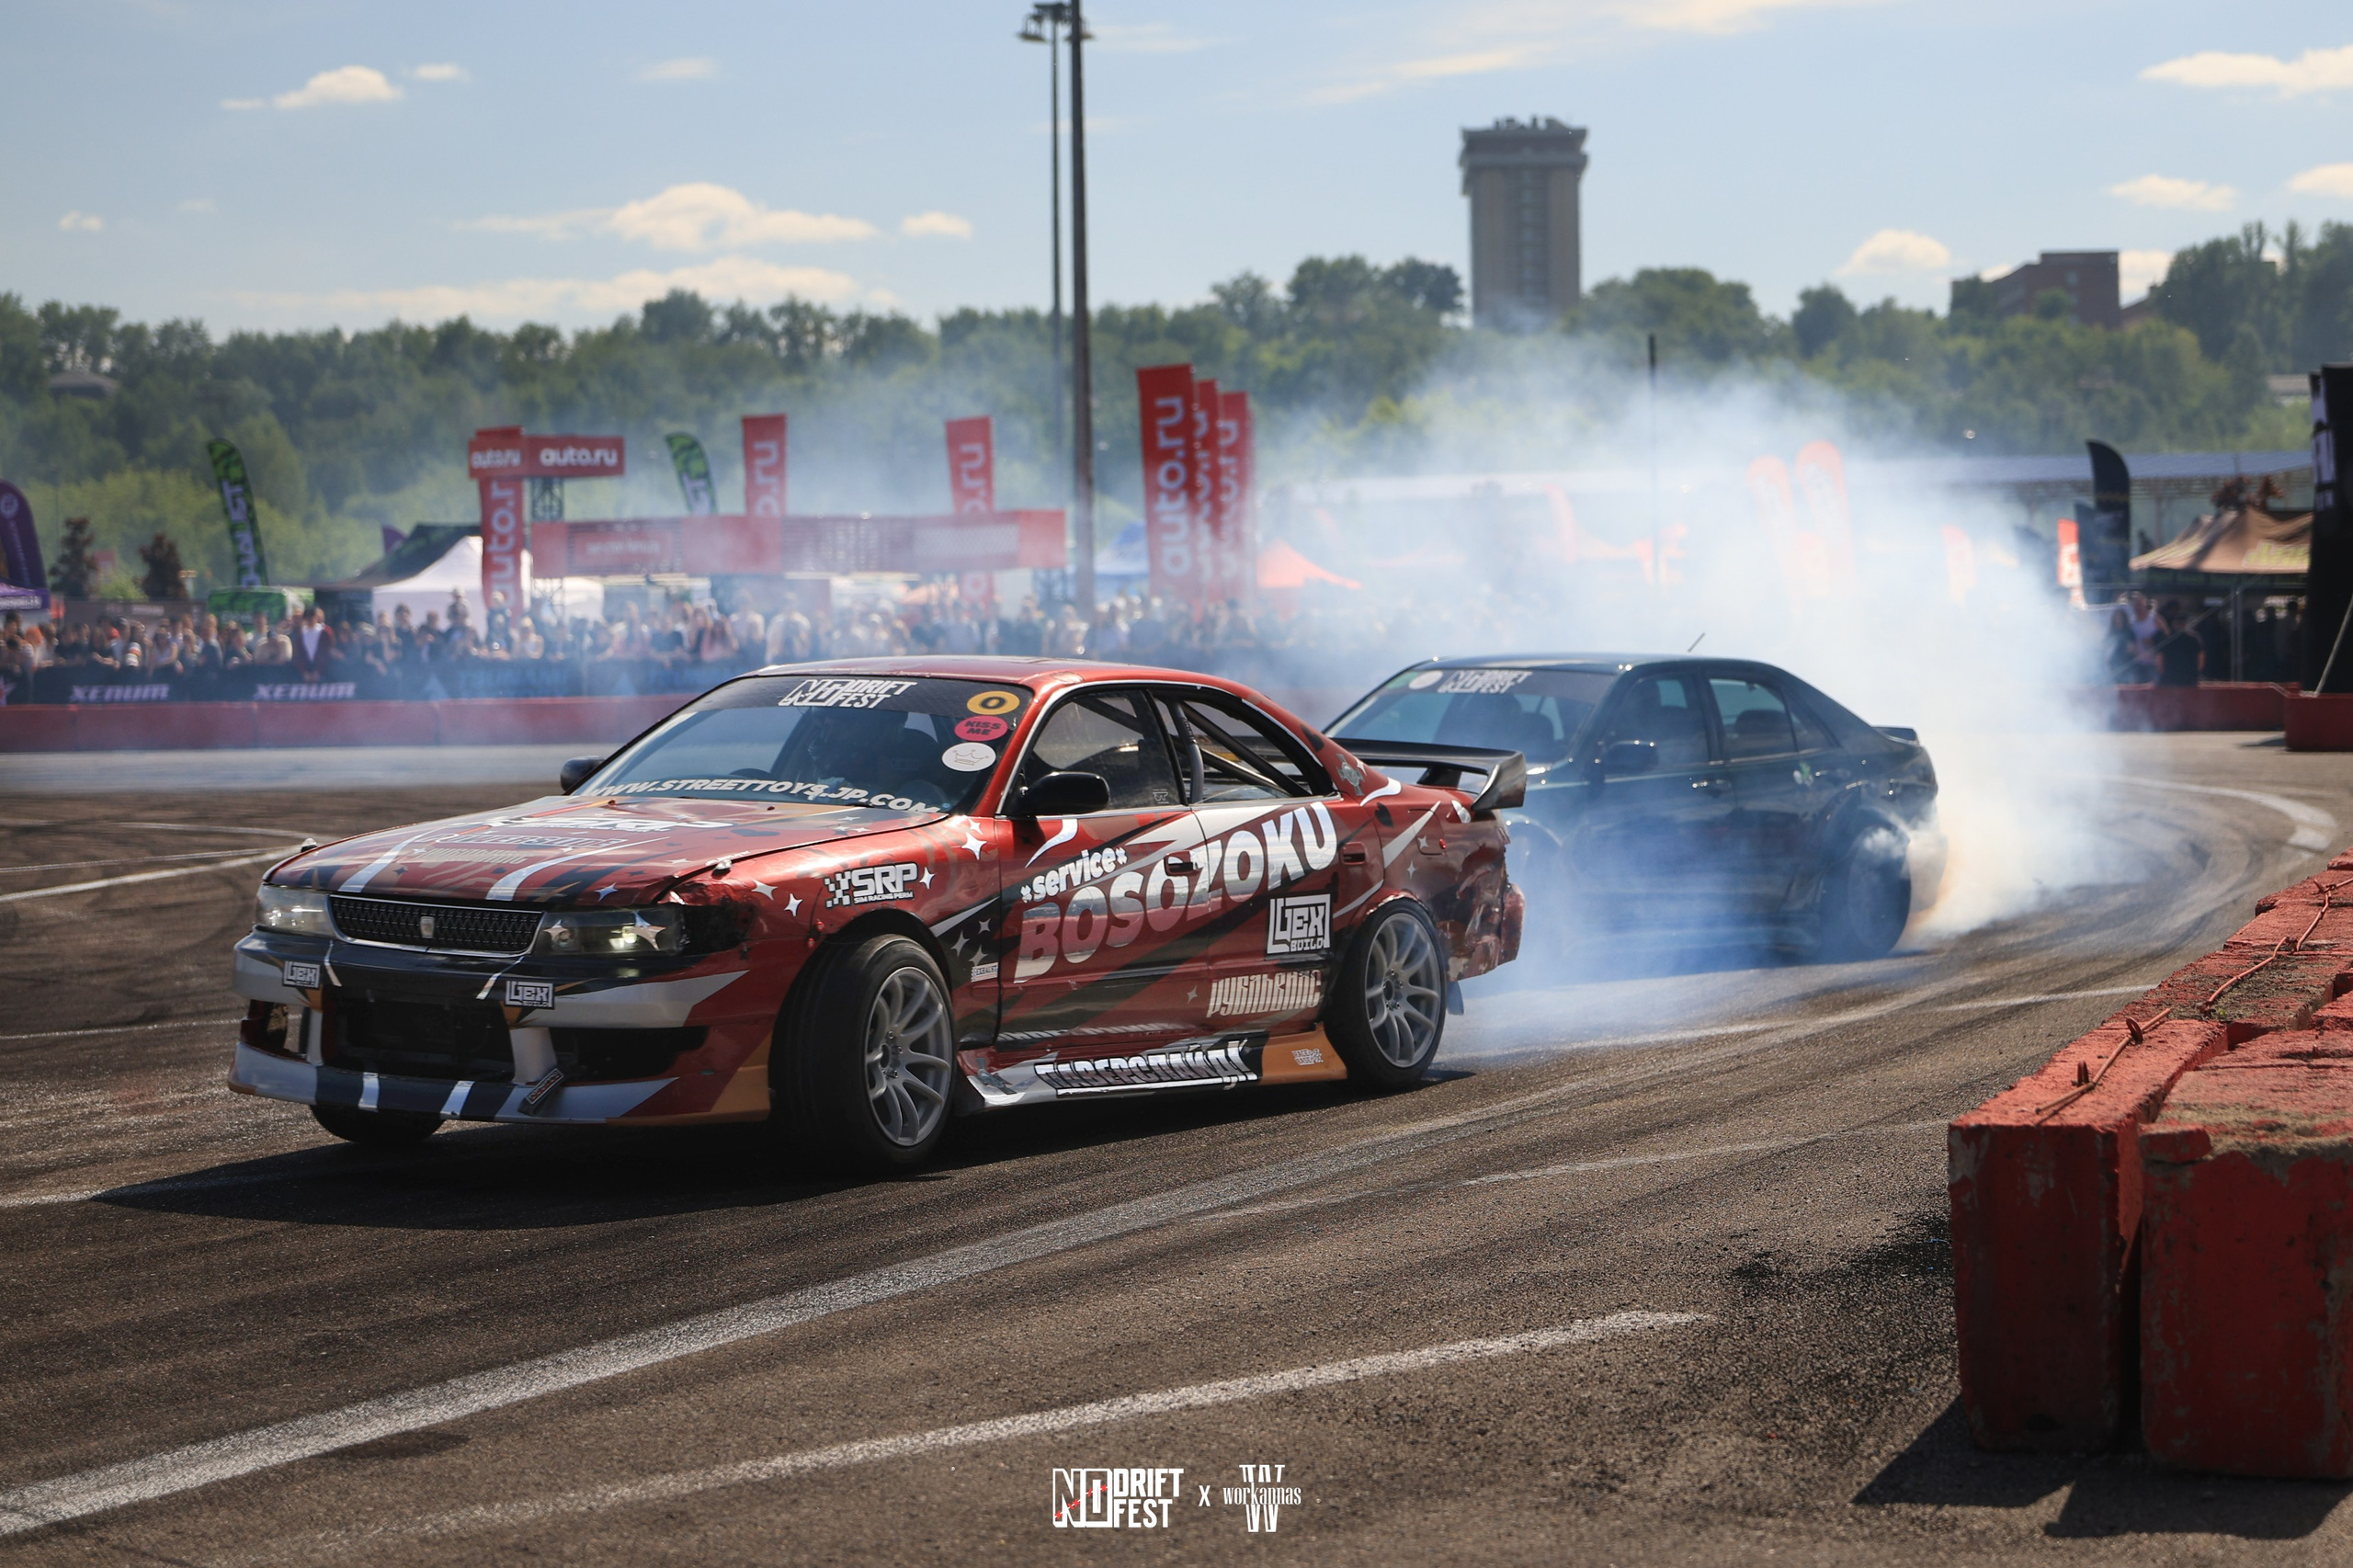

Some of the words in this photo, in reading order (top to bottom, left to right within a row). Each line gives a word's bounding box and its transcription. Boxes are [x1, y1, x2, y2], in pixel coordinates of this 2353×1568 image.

[471, 449, 521, 470] auto.ru
[540, 445, 619, 468] auto.ru
[1154, 395, 1193, 577] auto.ru
[488, 480, 517, 608] auto.r
[844, 680, 917, 695] DRIFT
[831, 693, 891, 708] FEST
[964, 721, 1002, 730] KISS
[852, 862, 918, 897] SRP
[854, 895, 869, 903] SIM
[868, 892, 894, 902] RACING
[893, 891, 914, 899] PERM
[1013, 801, 1338, 984] BOSOZOKU
[1290, 937, 1324, 952] BUILD
